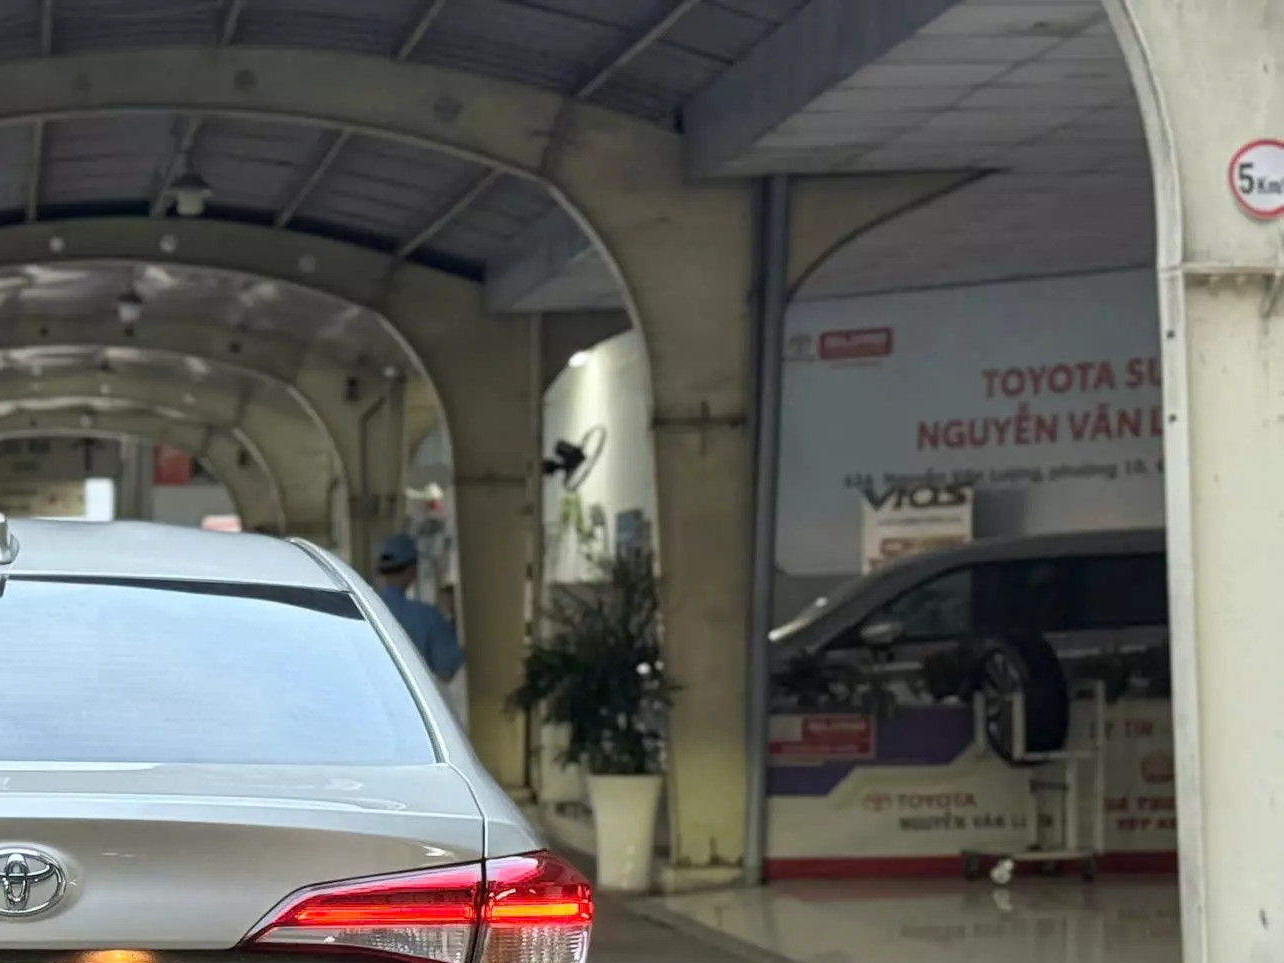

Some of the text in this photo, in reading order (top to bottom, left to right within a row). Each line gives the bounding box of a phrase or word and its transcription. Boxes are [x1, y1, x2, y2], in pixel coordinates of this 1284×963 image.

[982, 359, 1117, 398] TOYOTA
[917, 402, 1059, 450] NGUYỄN
[1069, 402, 1143, 442] VĂN
[898, 792, 977, 810] TOYOTA
